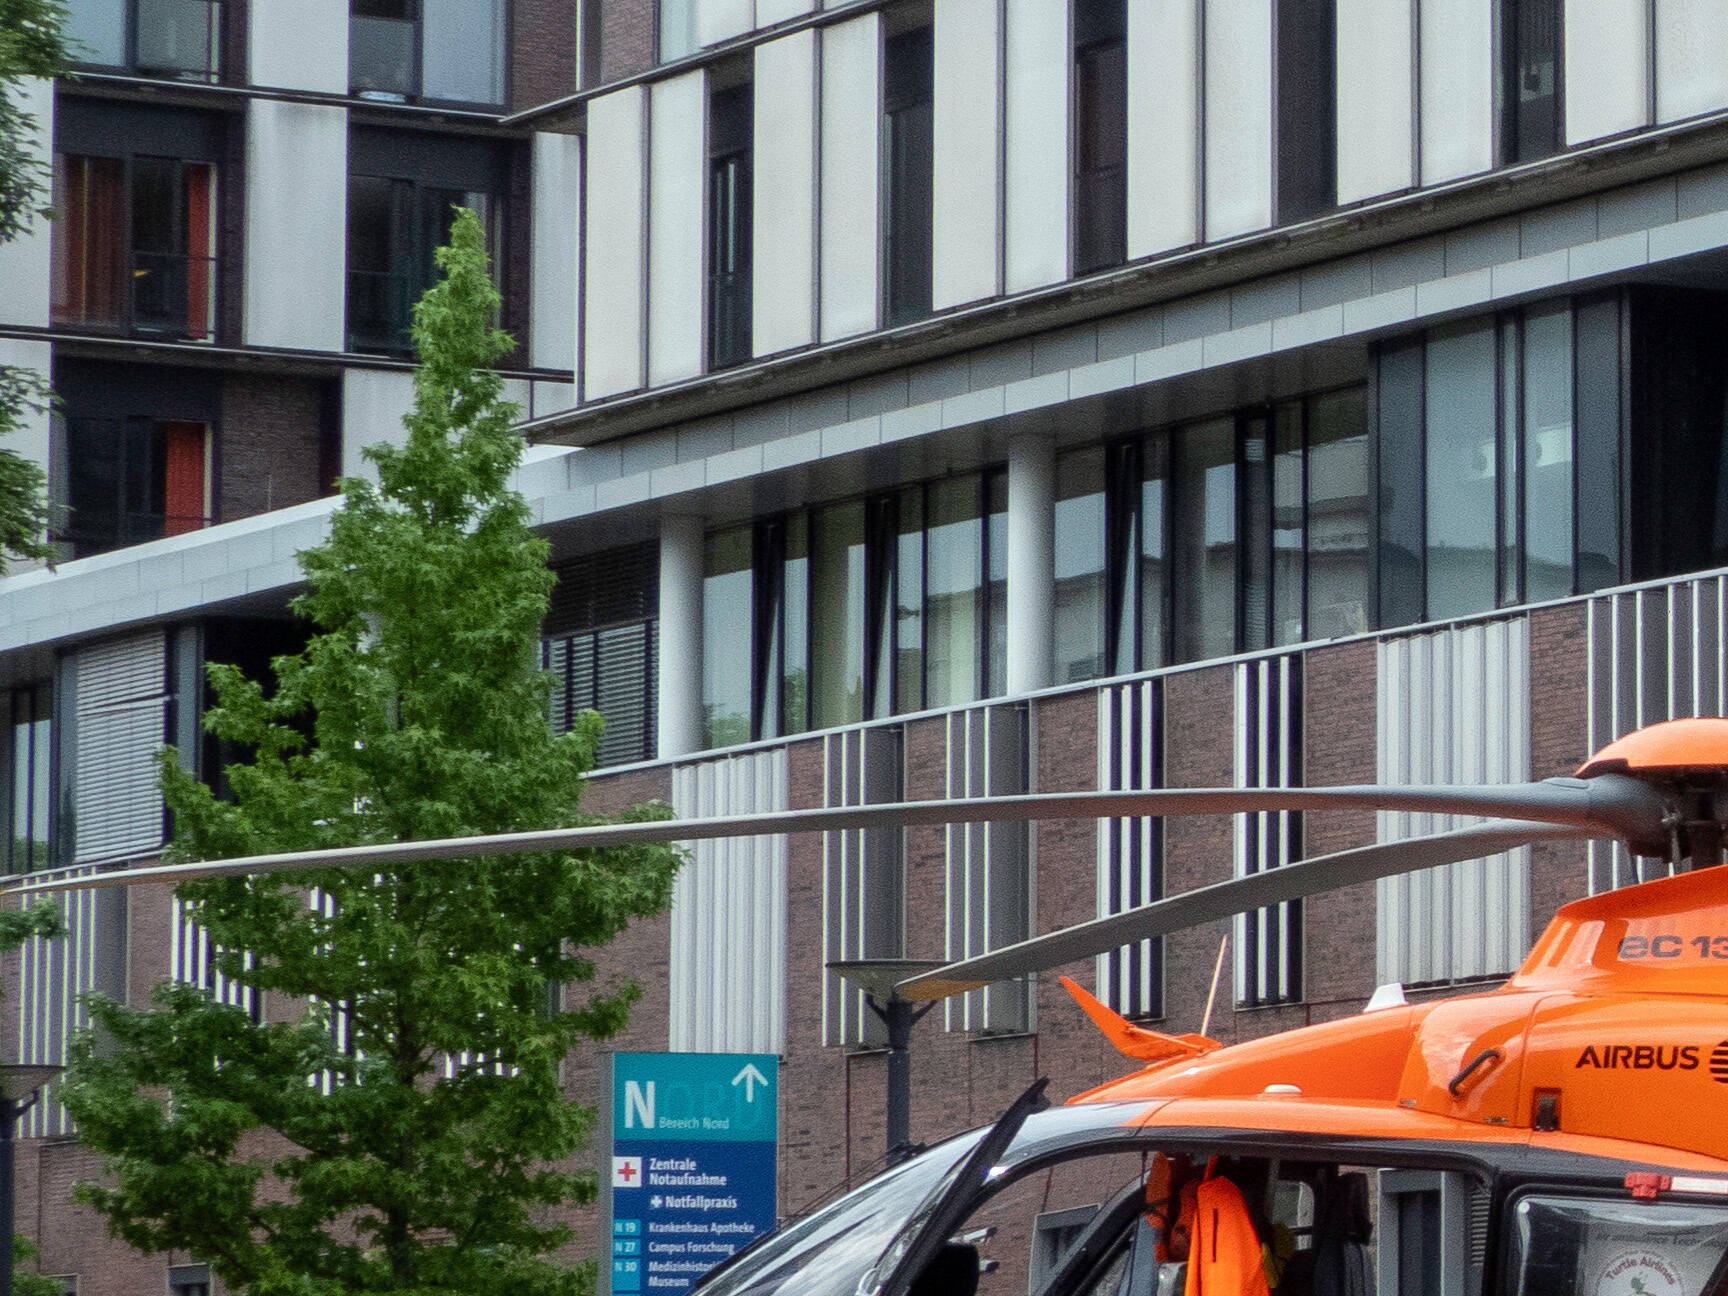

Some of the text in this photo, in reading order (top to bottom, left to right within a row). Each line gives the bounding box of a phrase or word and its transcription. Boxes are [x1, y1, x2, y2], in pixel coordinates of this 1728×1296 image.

[1575, 1044, 1700, 1071] AIRBUS
[659, 1116, 730, 1130] Bereich Nord
[649, 1157, 697, 1171] Zentrale
[649, 1172, 727, 1186] Notaufnahme
[665, 1195, 738, 1211] Notfallpraxis
[625, 1222, 635, 1232] 19
[648, 1221, 708, 1233] Krankenhaus
[710, 1221, 755, 1235] Apotheke
[625, 1241, 635, 1252] 27
[648, 1241, 686, 1255] Campus
[687, 1241, 736, 1256] Forschung
[624, 1261, 637, 1272] 30
[1604, 1255, 1676, 1286] Turtle Airlines
[648, 1276, 689, 1287] Museum
